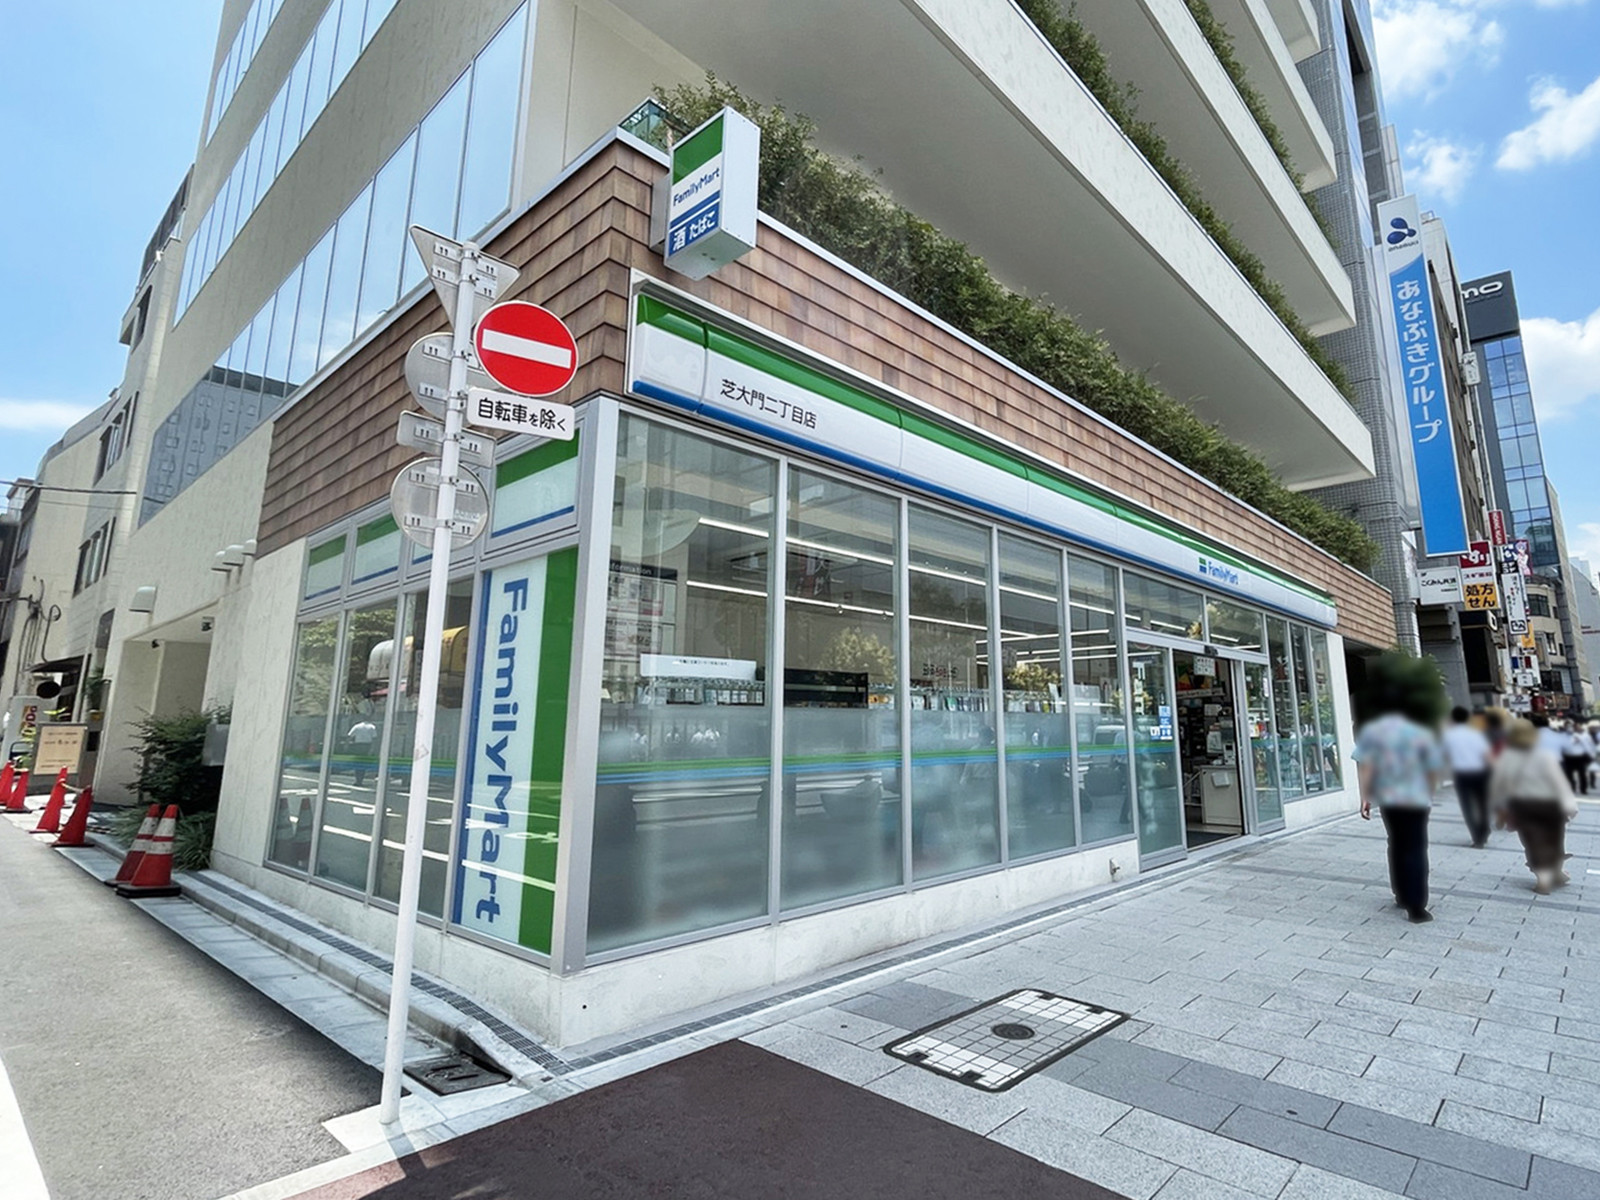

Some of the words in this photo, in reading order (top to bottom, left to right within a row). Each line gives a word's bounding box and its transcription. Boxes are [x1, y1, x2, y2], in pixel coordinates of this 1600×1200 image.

[673, 167, 720, 207] FamilyMart
[672, 226, 687, 251] 酒
[689, 211, 716, 240] たばこ
[1395, 280, 1443, 444] あなぶきグループ
[477, 397, 566, 432] 自転車を除く
[720, 378, 817, 430] 芝大門二丁目店
[1466, 584, 1494, 597] 処方
[1469, 597, 1495, 609] せん
[475, 577, 529, 924] FamilyMart
